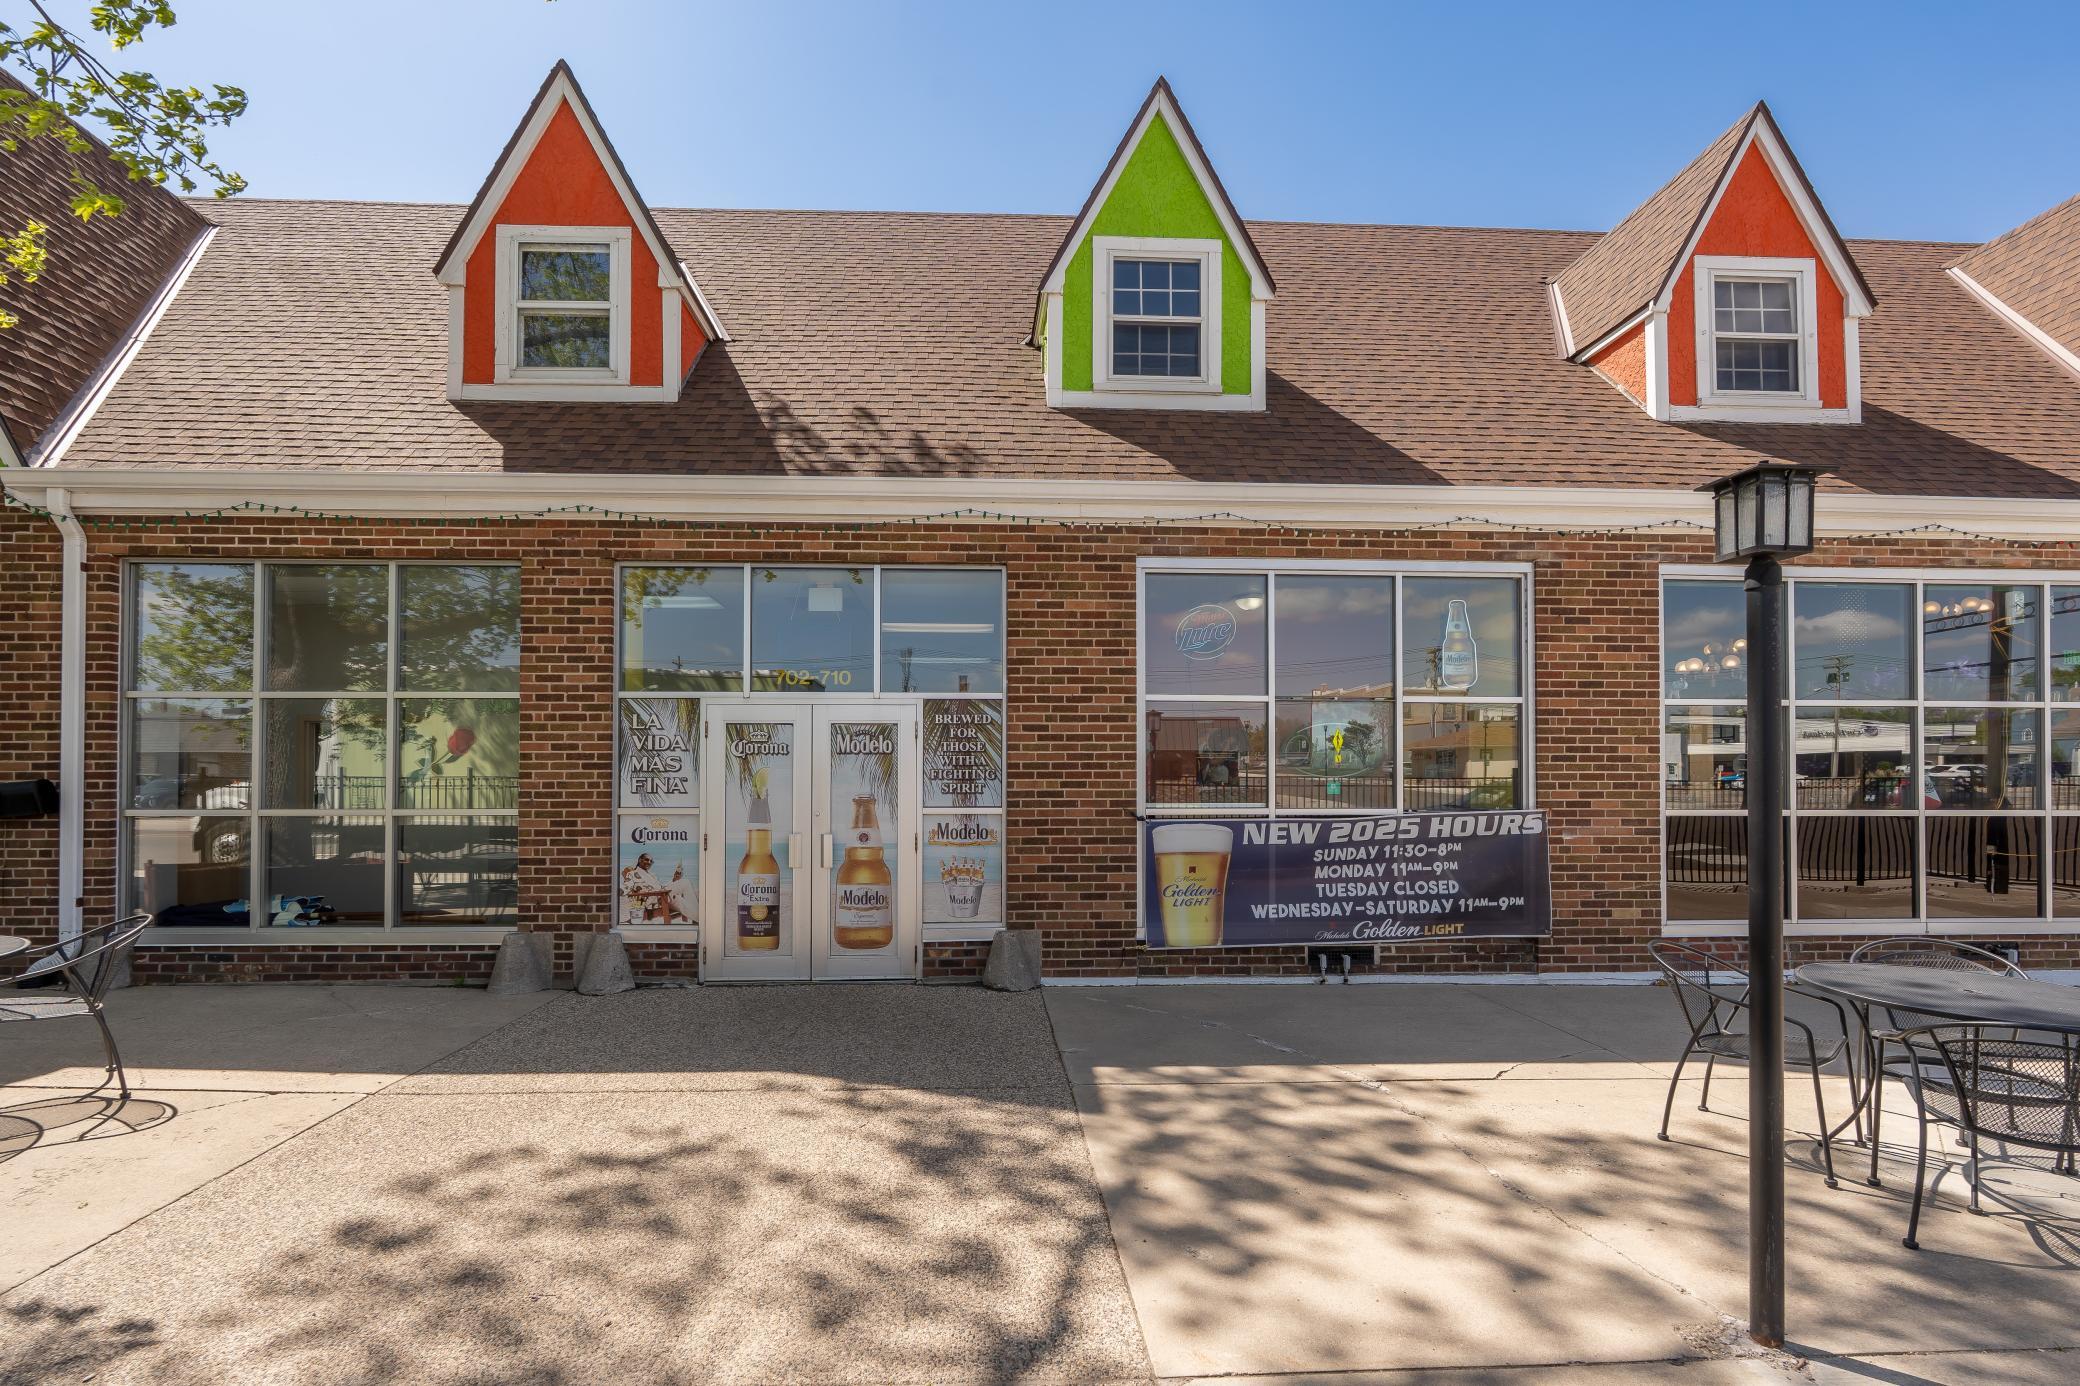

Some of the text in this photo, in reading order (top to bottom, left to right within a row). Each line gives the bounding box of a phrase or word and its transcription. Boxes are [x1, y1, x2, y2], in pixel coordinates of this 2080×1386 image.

[776, 669, 852, 685] 702-710
[632, 713, 664, 730] LA
[935, 714, 992, 724] BREWED
[949, 727, 977, 738] FOR
[632, 735, 689, 752] VIDA
[730, 739, 790, 758] Corona
[836, 733, 894, 754] Modelo
[941, 741, 986, 752] THOSE
[939, 755, 987, 766] WITH A
[930, 769, 997, 780] FIGHTING
[941, 783, 986, 794] SPIRIT
[631, 826, 688, 845] Corona
[937, 822, 988, 840] Modelo
[1243, 814, 1543, 845] NEW 2025 HOURS
[1313, 846, 1379, 862] SUNDAY
[1314, 863, 1386, 879] MONDAY
[741, 882, 777, 896] Corona
[843, 889, 885, 905] Modelo
[1163, 882, 1221, 897] Golden
[1315, 880, 1460, 898] TUESDAY CLOSED
[949, 895, 977, 905] Modelo
[1173, 898, 1209, 907] LIGHT
[1352, 918, 1423, 939] Golden
[1424, 922, 1464, 936] LIGHT
